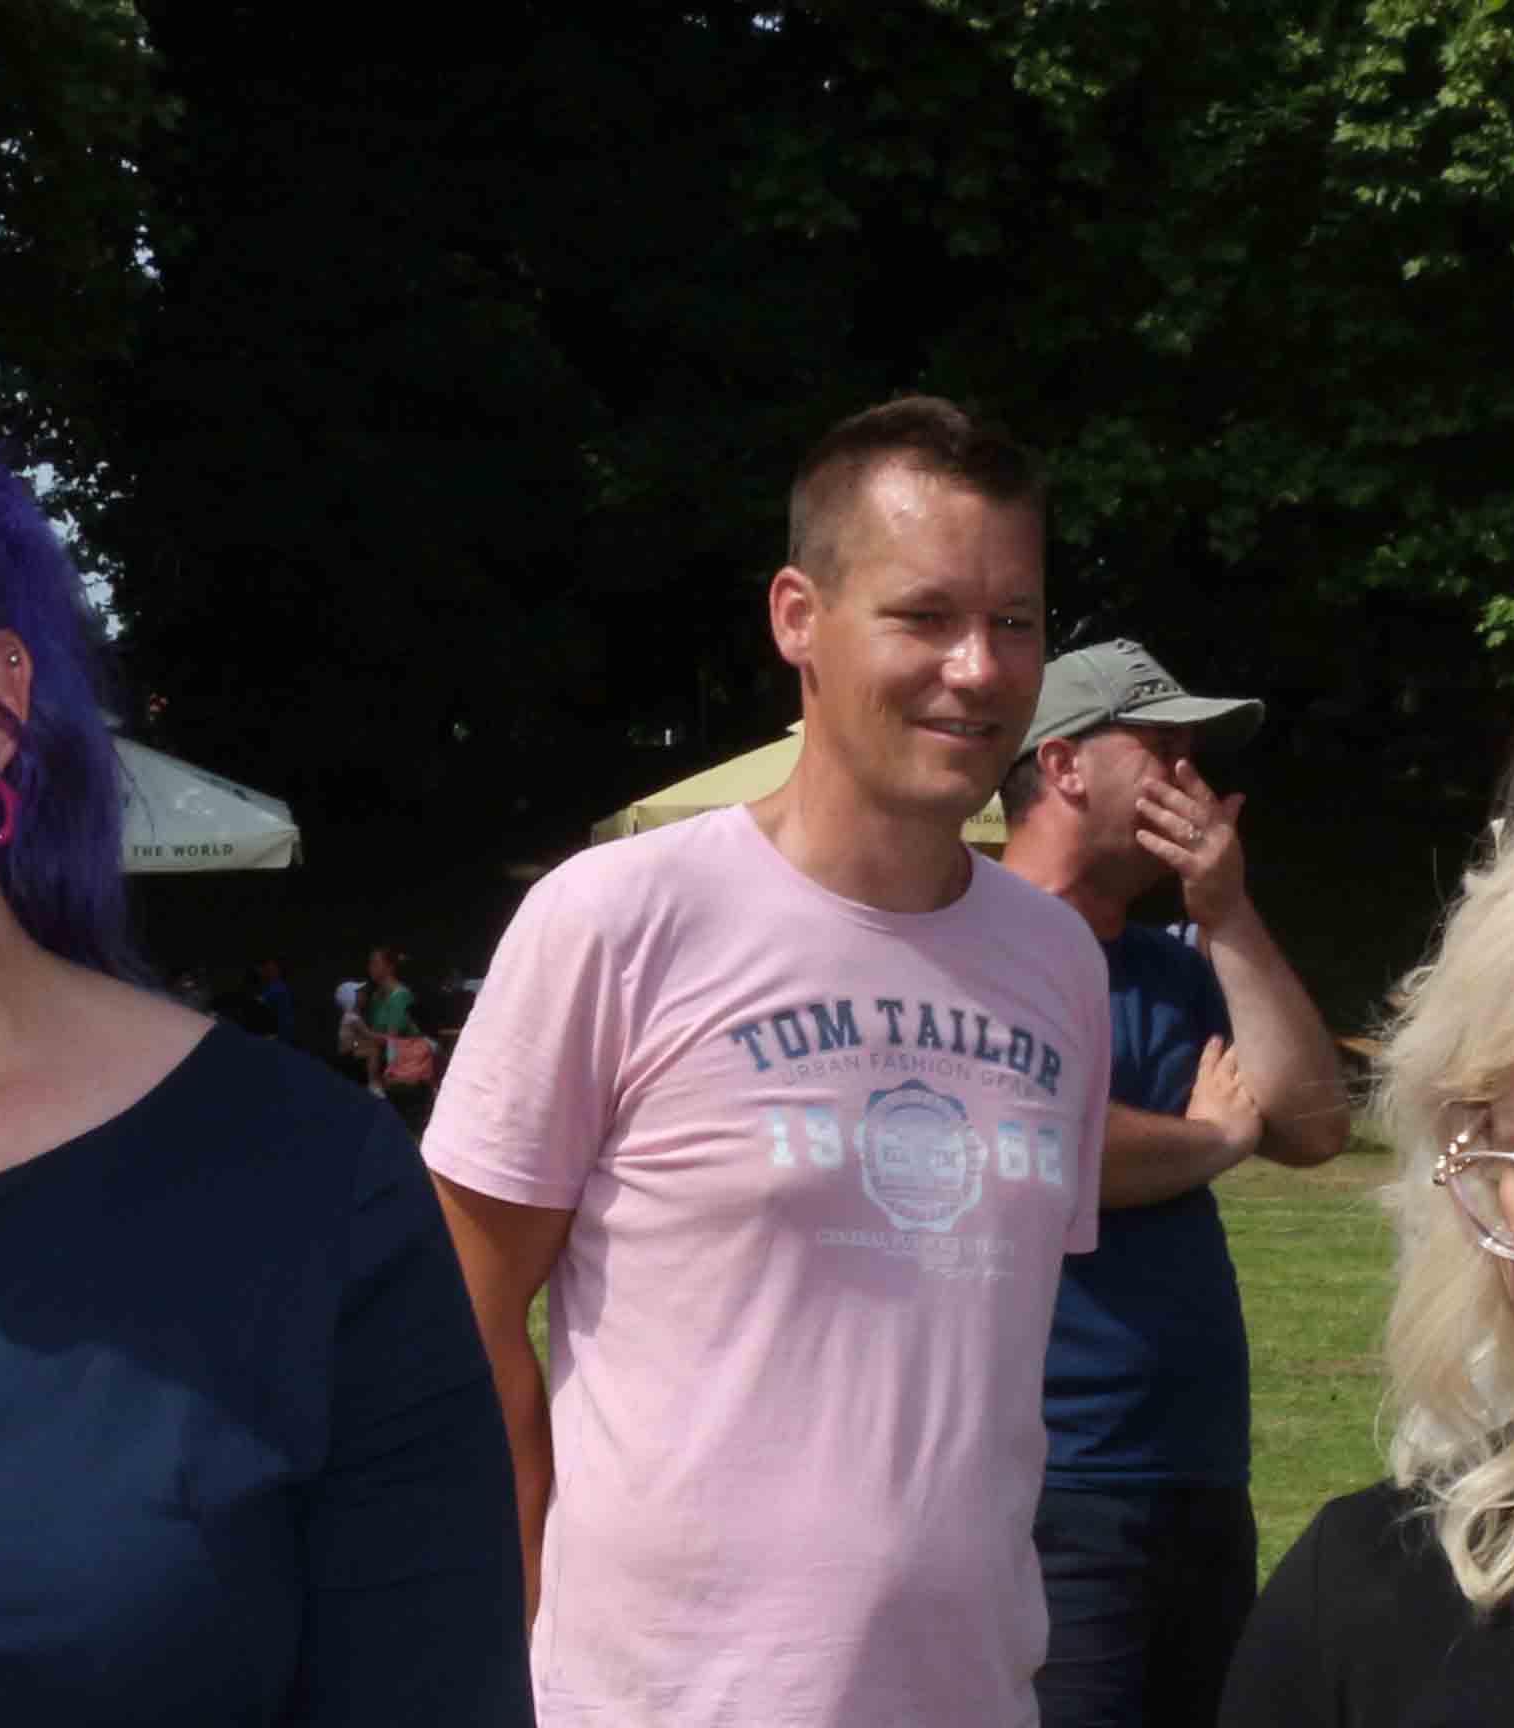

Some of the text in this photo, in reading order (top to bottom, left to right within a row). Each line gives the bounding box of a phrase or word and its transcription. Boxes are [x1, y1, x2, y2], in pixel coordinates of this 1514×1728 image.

[173, 843, 235, 858] WORLD
[731, 998, 1063, 1096] TOM TAILOR
[784, 1052, 973, 1087] URBAN FASHION
